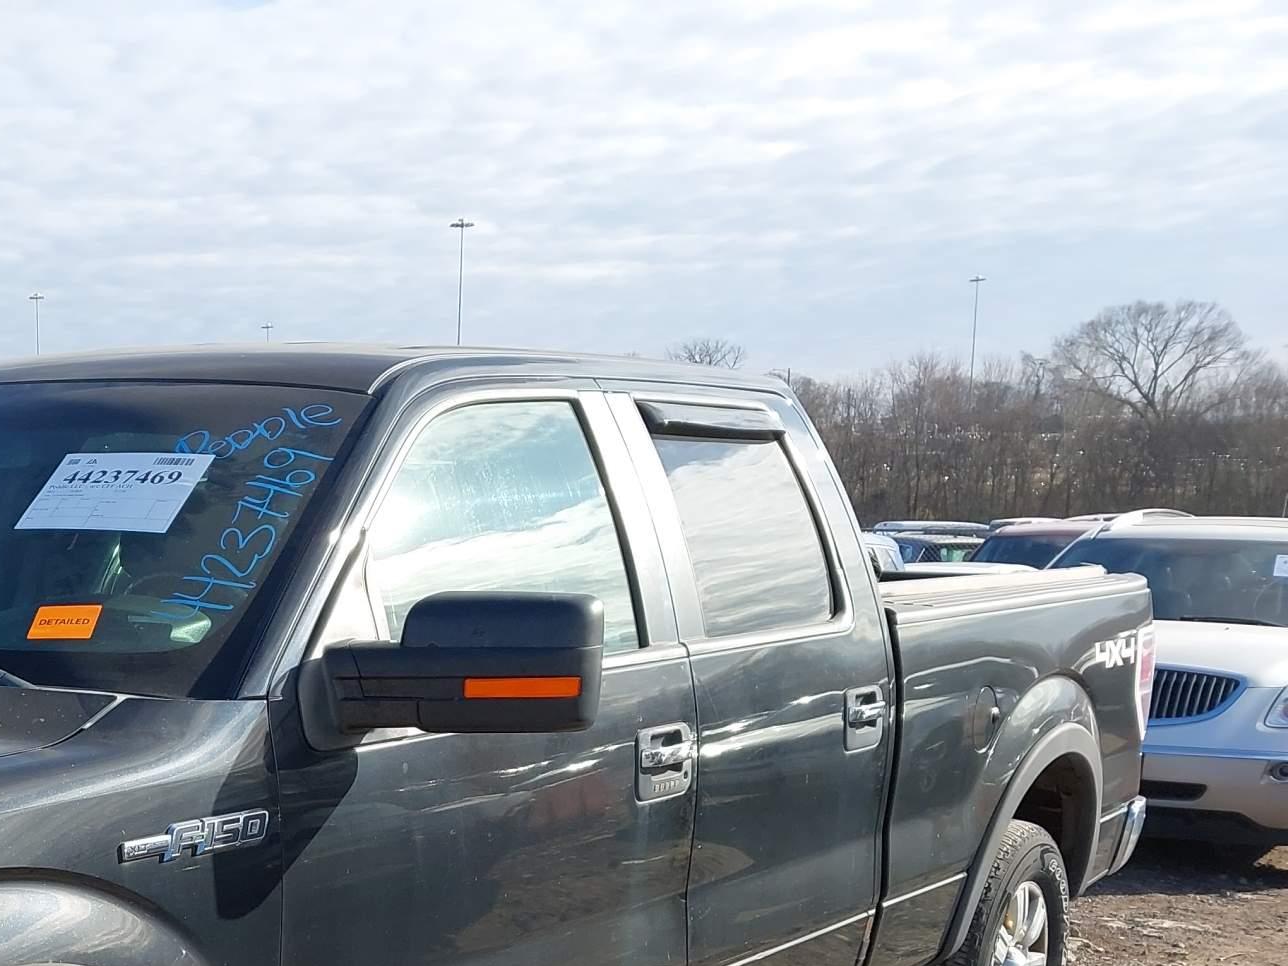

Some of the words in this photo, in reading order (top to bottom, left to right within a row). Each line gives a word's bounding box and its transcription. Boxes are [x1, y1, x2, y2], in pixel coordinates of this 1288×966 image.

[62, 470, 183, 485] 44237469
[152, 447, 334, 621] 44237469
[38, 617, 91, 626] DETAILED
